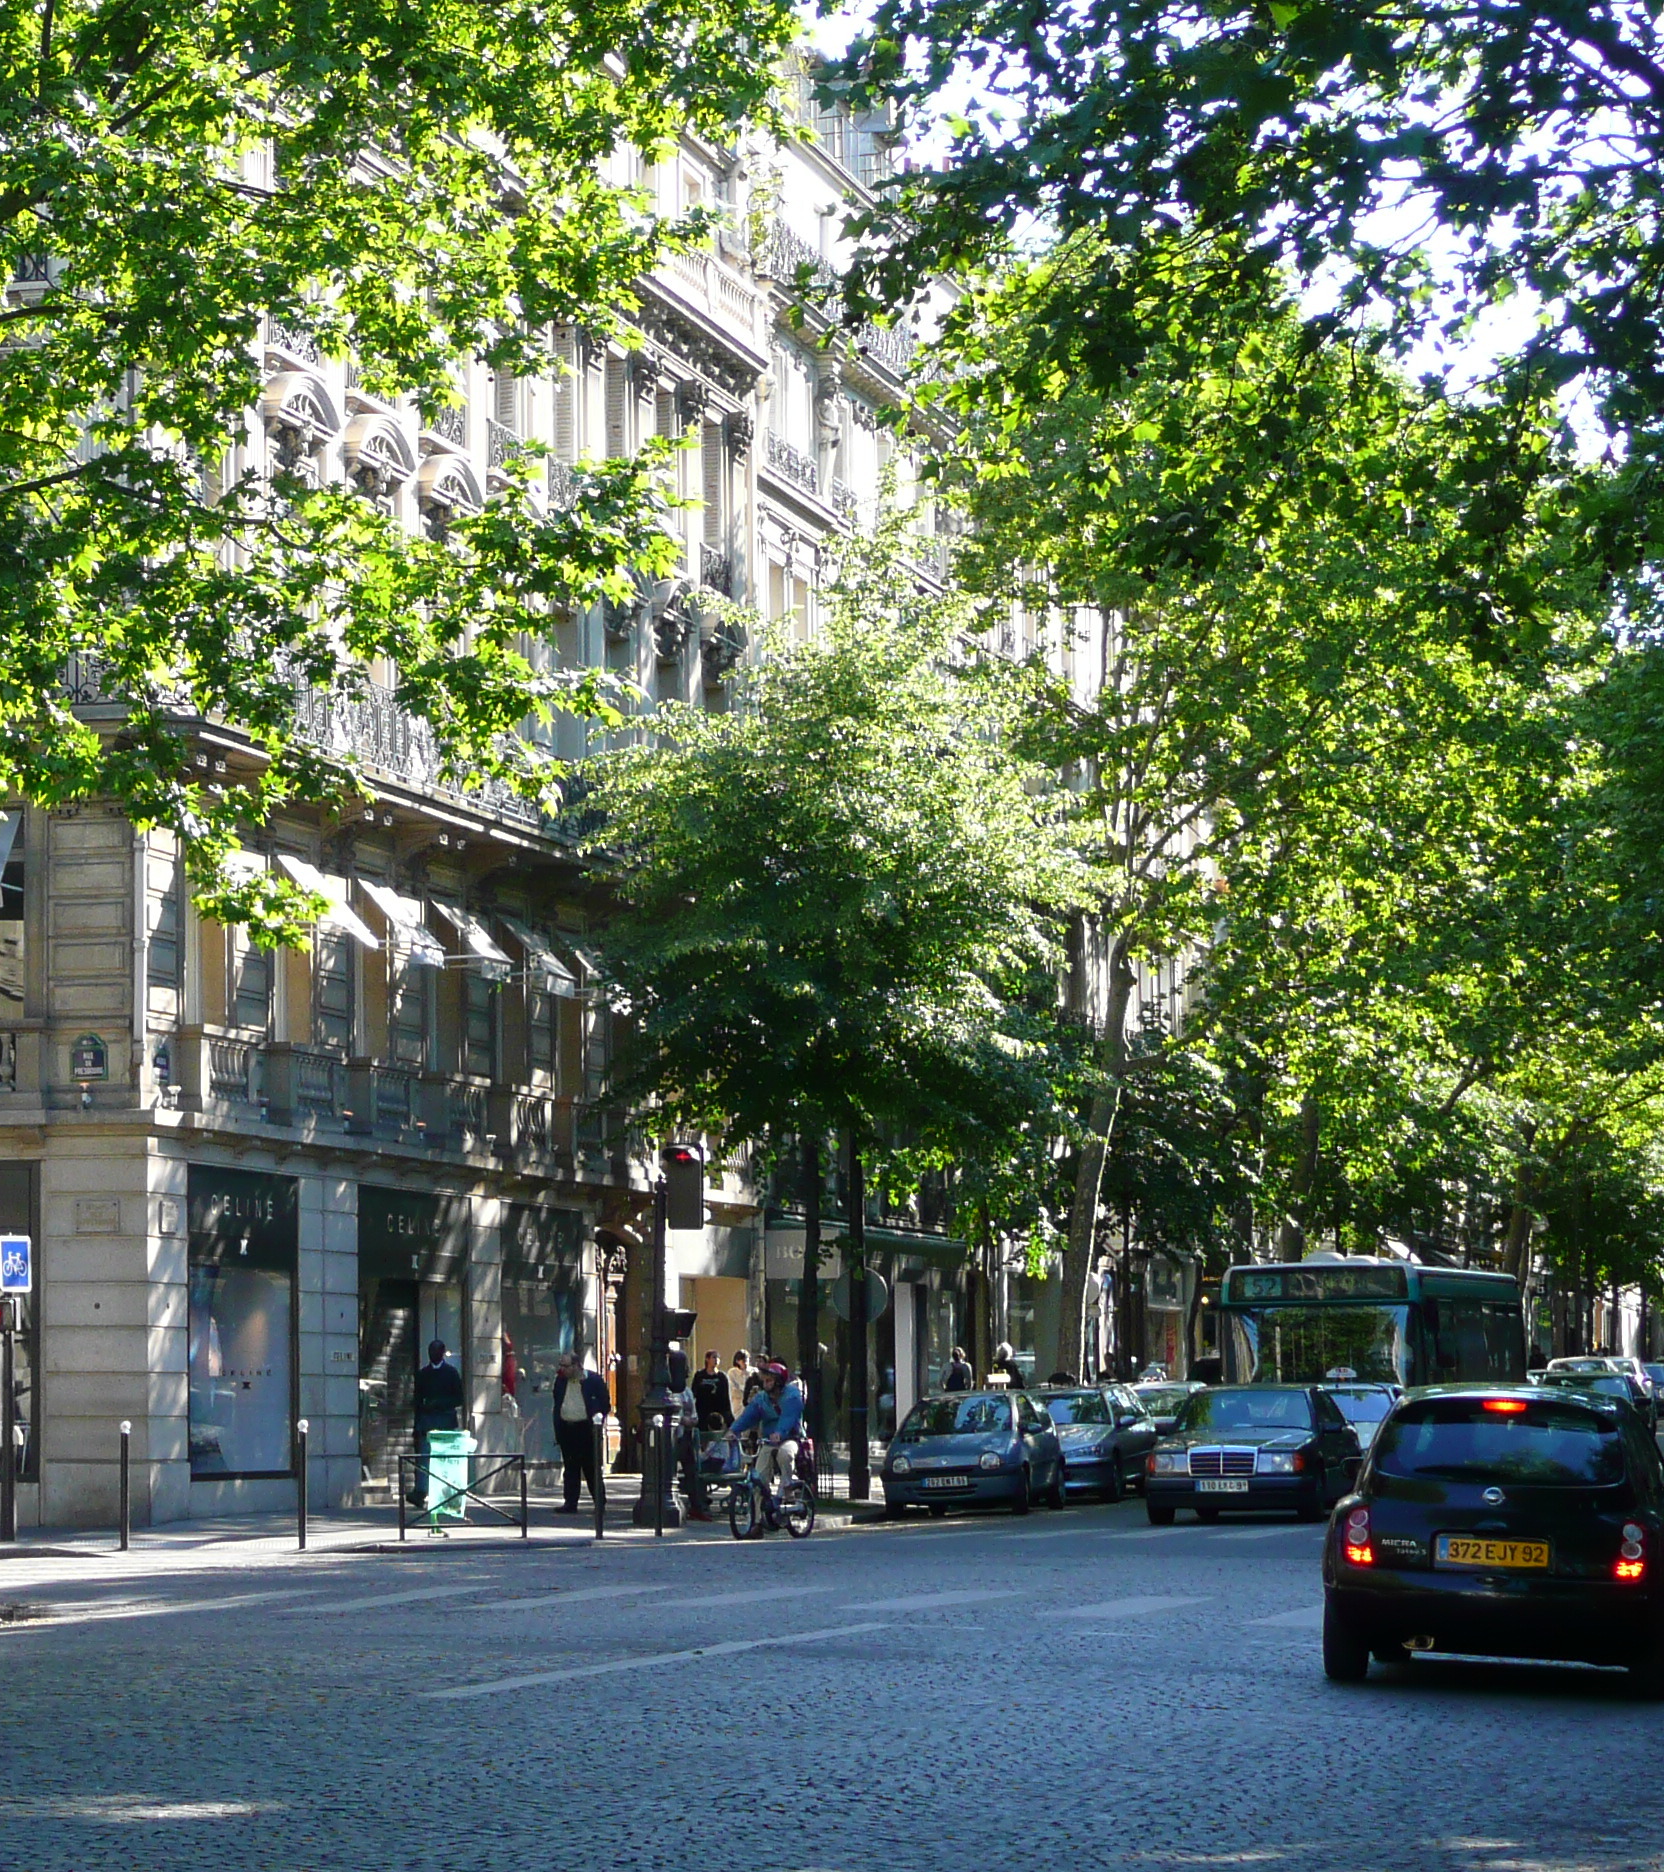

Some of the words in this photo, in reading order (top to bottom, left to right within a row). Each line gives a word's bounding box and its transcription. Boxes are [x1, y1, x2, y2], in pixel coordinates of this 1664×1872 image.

[211, 1194, 274, 1220] CELINE
[1381, 1538, 1417, 1548] MICRA
[1449, 1541, 1482, 1559] 372
[1485, 1543, 1517, 1561] EJY
[1521, 1545, 1544, 1563] 92
